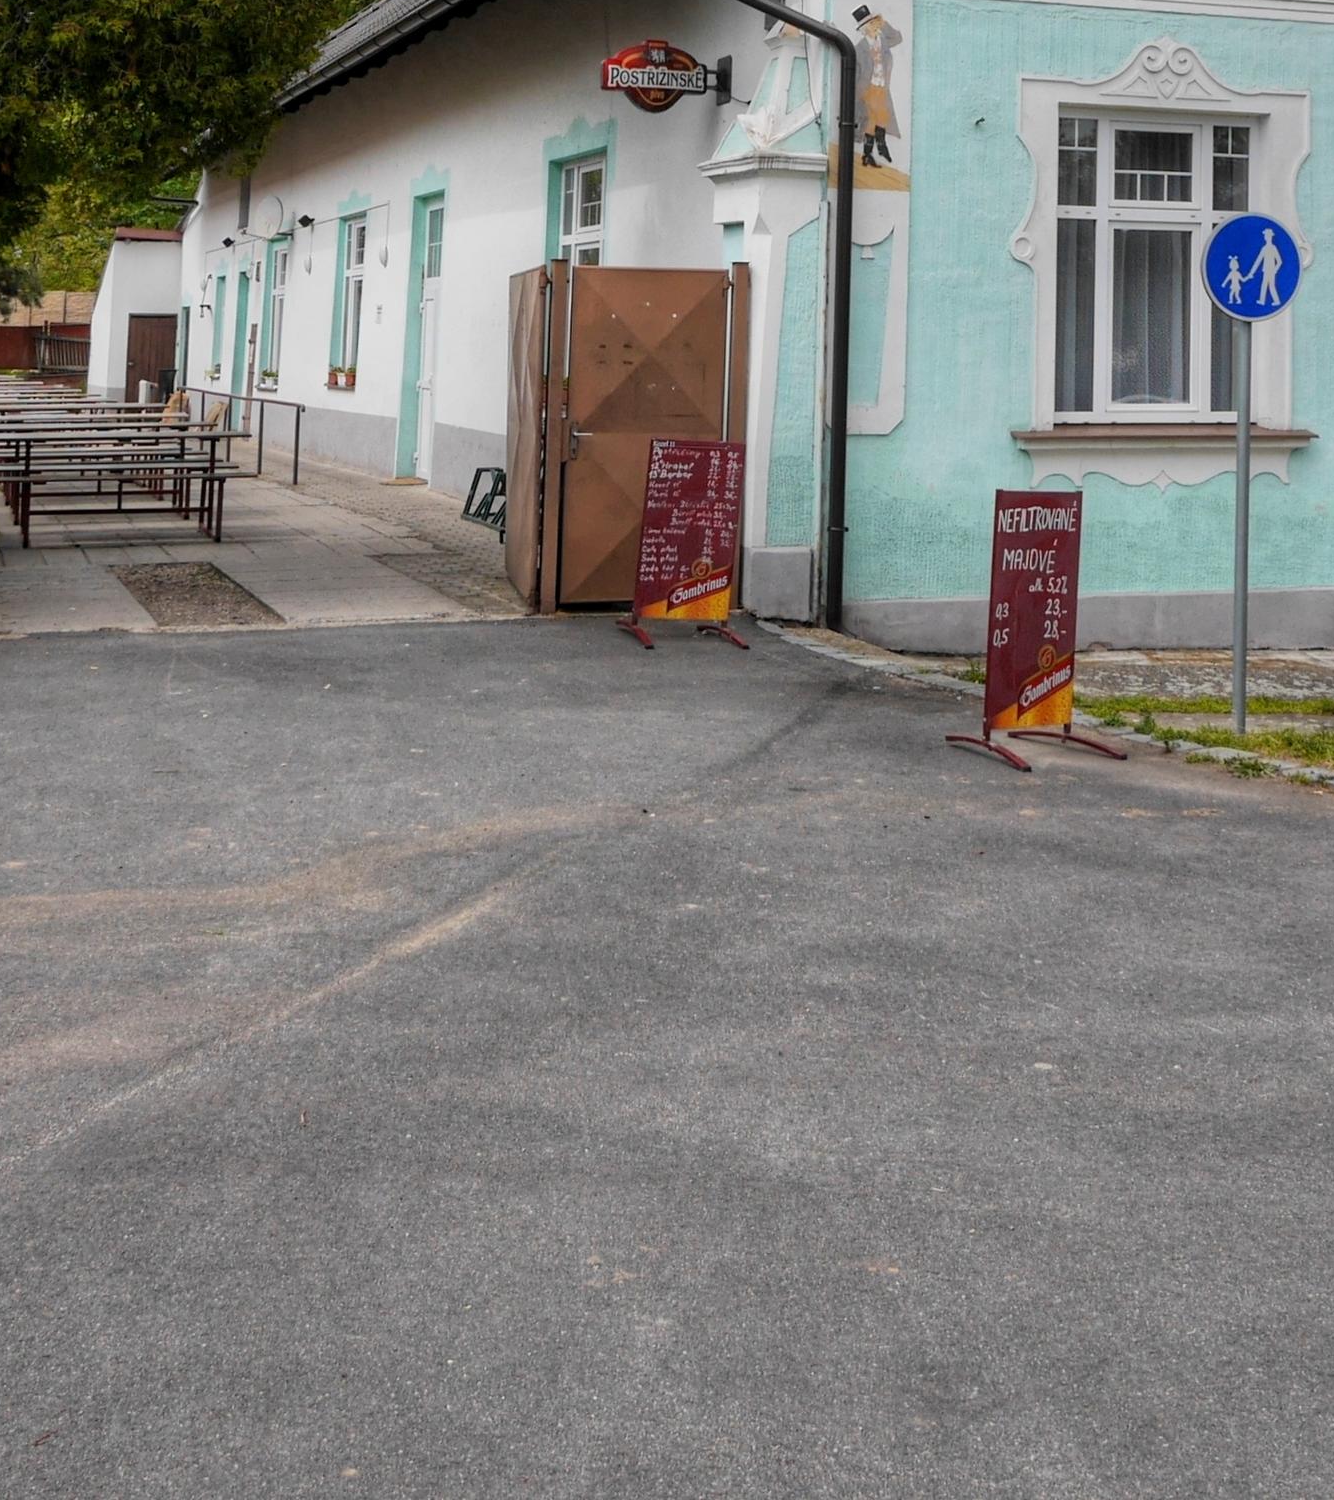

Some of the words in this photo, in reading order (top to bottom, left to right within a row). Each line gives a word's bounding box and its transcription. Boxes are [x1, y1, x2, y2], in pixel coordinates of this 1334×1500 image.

[997, 500, 1078, 533] NEFILTROVANÉ
[1002, 538, 1058, 574] MAJOVÉ
[670, 575, 728, 604] Gambrinus
[1045, 598, 1067, 618] 23,-
[993, 628, 1009, 648] 0,5
[1044, 620, 1066, 640] 28,-
[1019, 664, 1071, 707] Gambrinus
